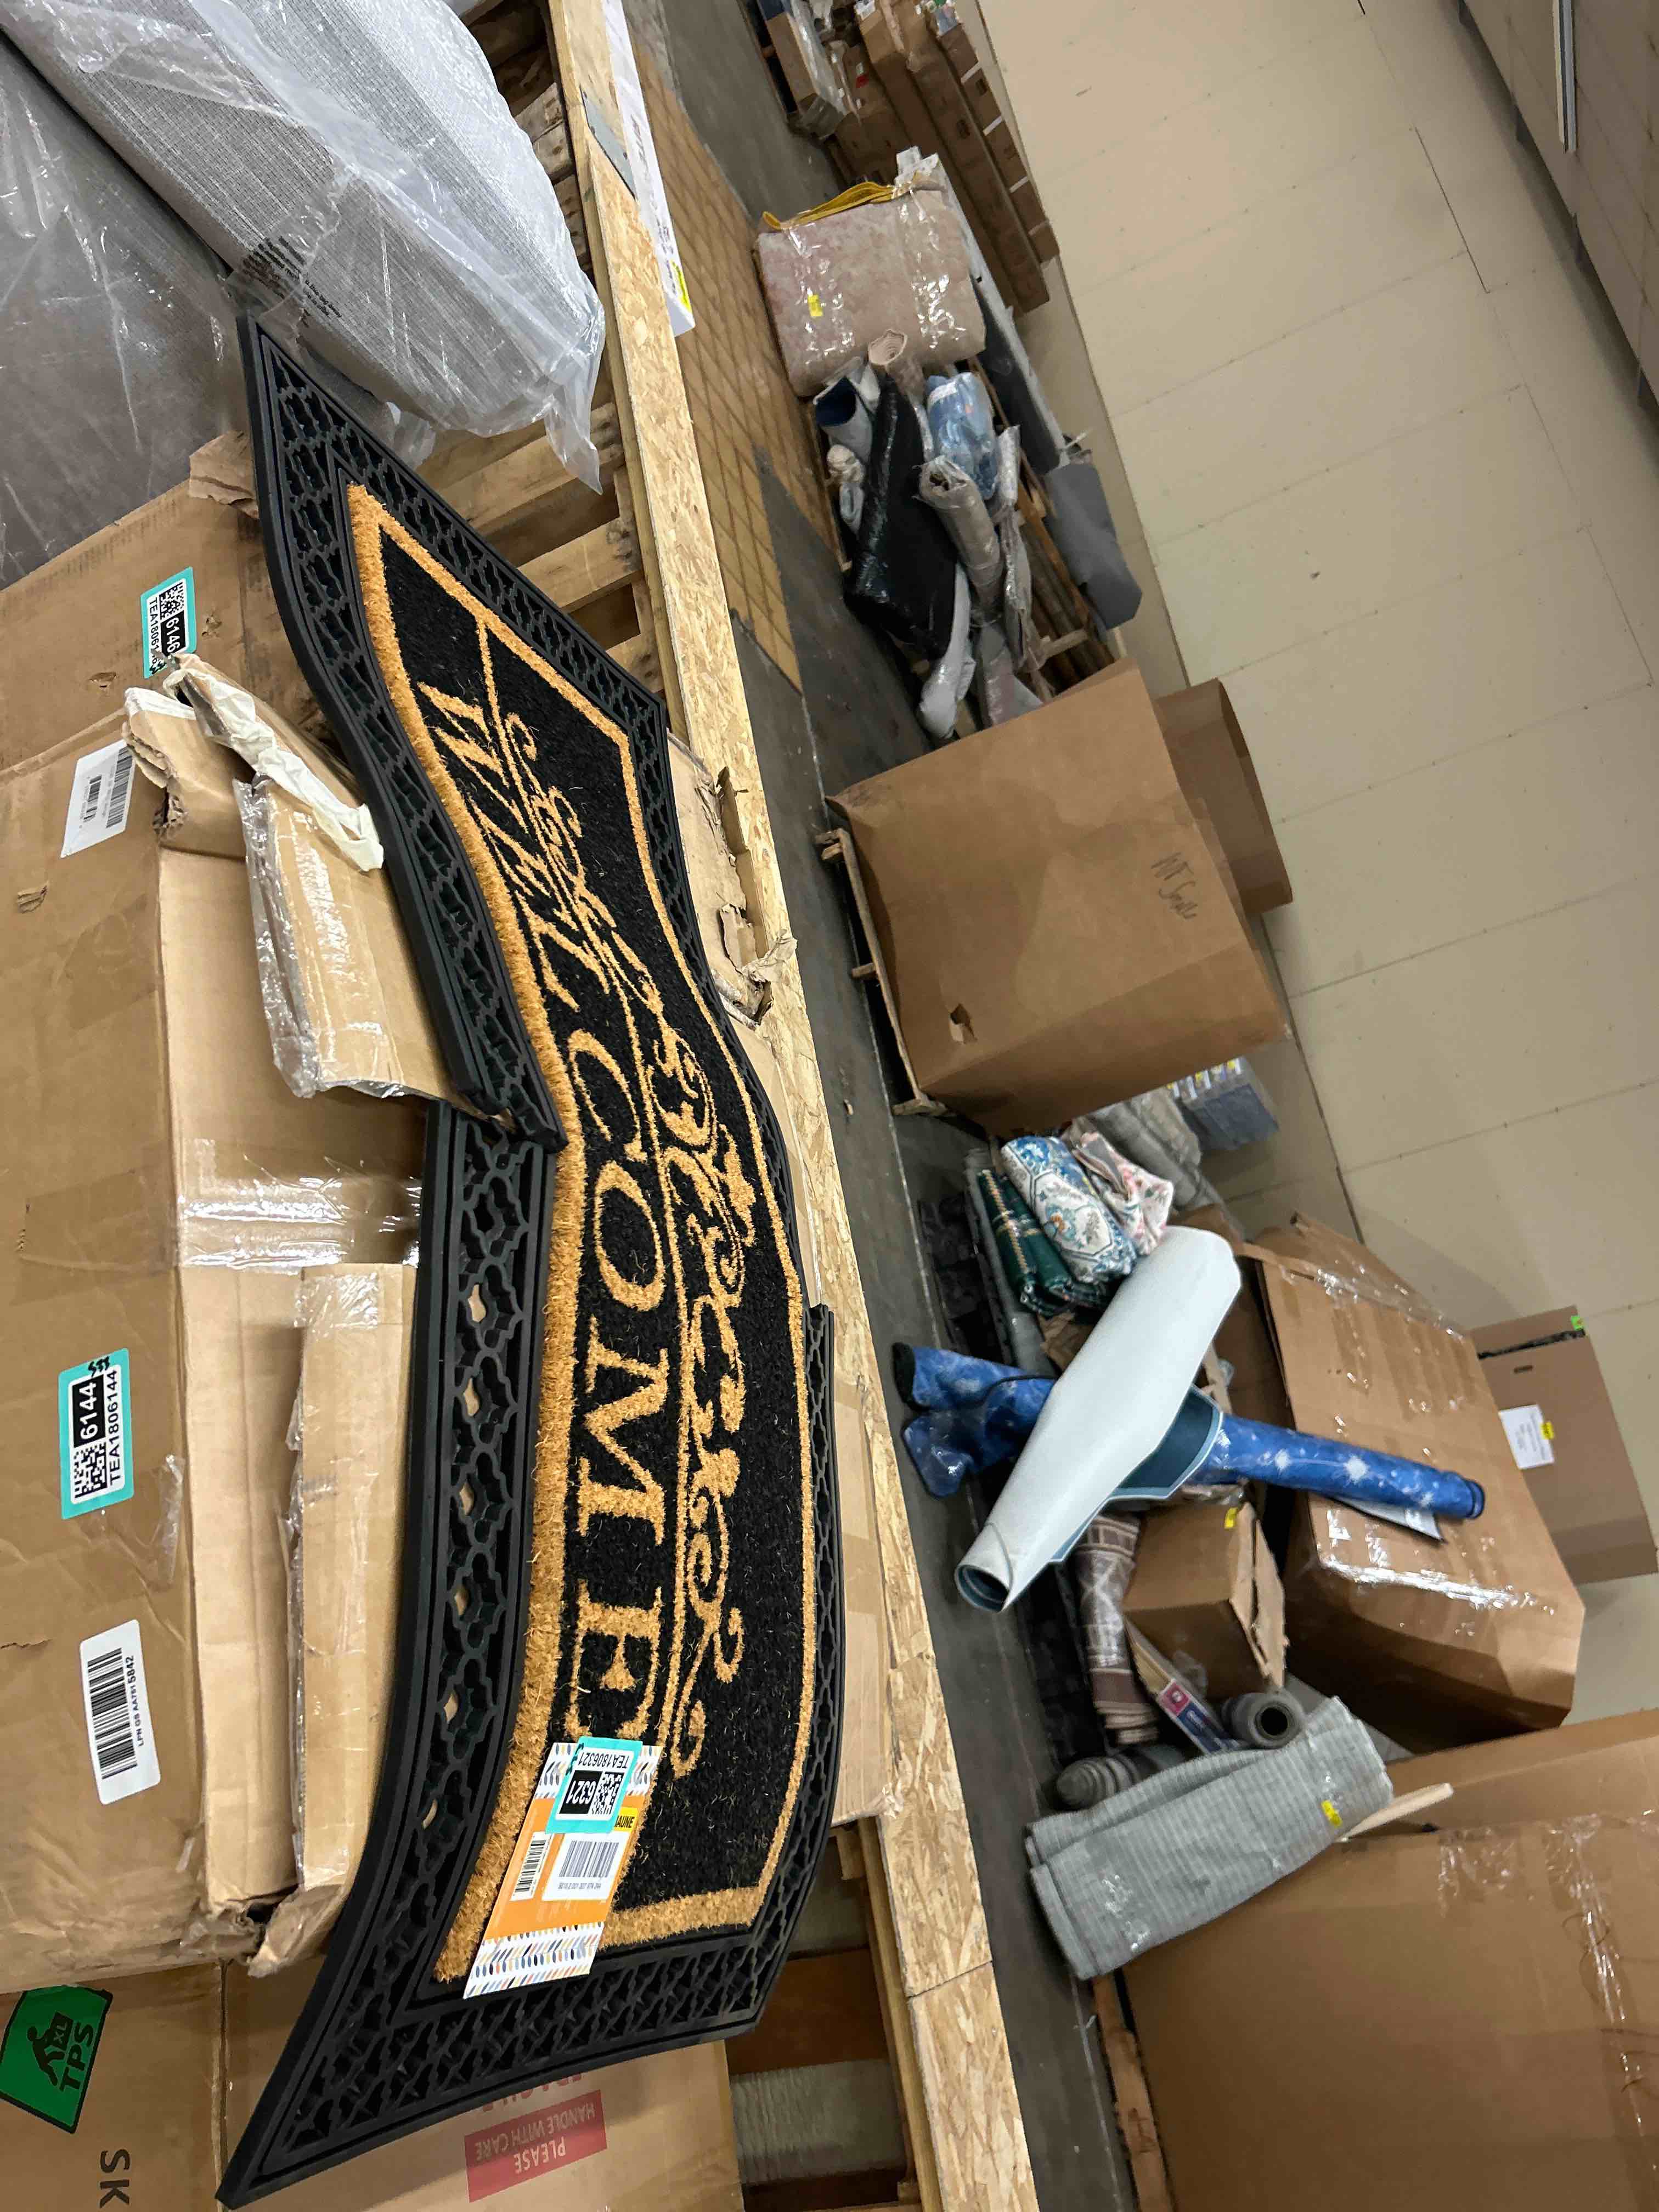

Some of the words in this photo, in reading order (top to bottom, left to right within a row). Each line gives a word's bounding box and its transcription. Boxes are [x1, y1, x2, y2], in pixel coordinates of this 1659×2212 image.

[149, 597, 160, 664] TEA180616
[165, 617, 180, 654] 6146
[416, 680, 670, 1740] WELCOME
[78, 1382, 99, 1440] 6144
[106, 1369, 121, 1485] TEA1806144
[578, 1752, 630, 1769] TEA1806321
[566, 1780, 596, 1804] 6321
[59, 2021, 94, 2091] TPS
[510, 2119, 545, 2148] WITH
[546, 2102, 595, 2136] HANDLE
[475, 2132, 510, 2163] CARE
[513, 2136, 567, 2174] PLEASE
[99, 2149, 131, 2208] SK
